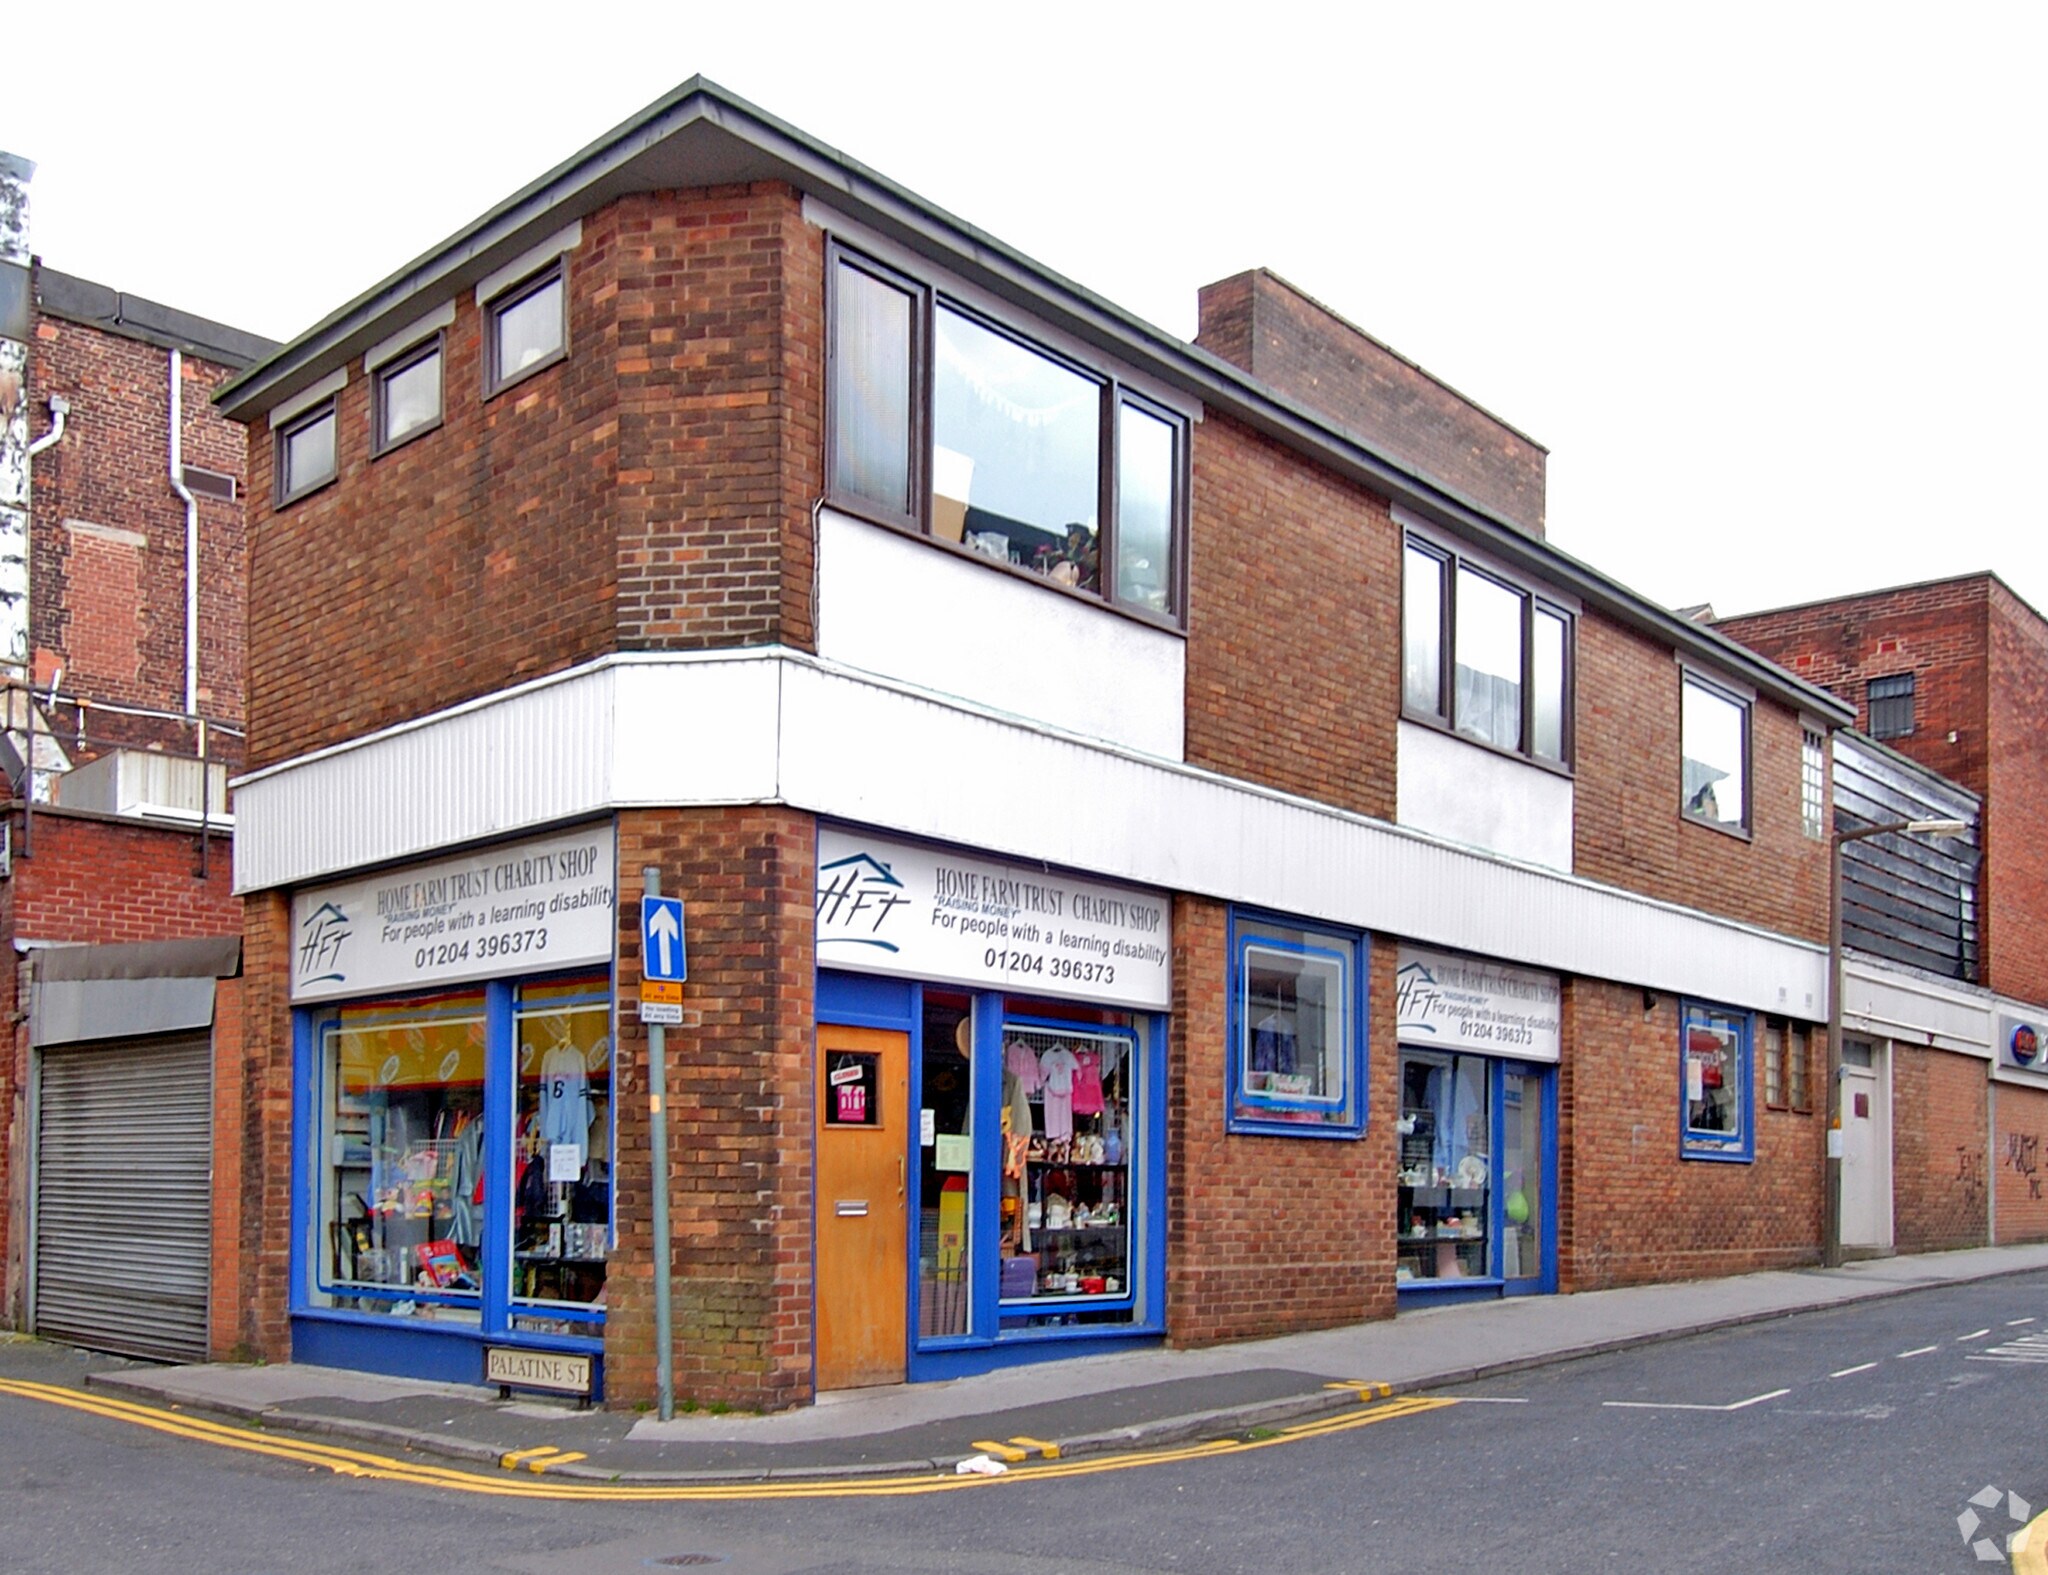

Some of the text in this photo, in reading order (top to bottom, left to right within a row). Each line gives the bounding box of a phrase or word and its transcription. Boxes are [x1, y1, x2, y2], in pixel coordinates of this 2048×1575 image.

[377, 845, 598, 916] HOME FARM TRUST CHARITY SHOP
[936, 867, 1161, 934] HOME FARM TRUST CHARITY SHOP
[381, 885, 614, 944] For people with a learning disability
[415, 927, 548, 969] 01204 396373
[931, 908, 1167, 967] For people with a learning disability
[984, 948, 1115, 984] 01204 396373
[1432, 999, 1447, 1014] For
[1447, 1004, 1474, 1021] people
[1475, 1006, 1491, 1021] with
[1497, 1009, 1526, 1031] learning
[1527, 1014, 1559, 1035] disability
[1460, 1020, 1533, 1045] 01204 396373
[490, 1354, 562, 1382] PALATINE
